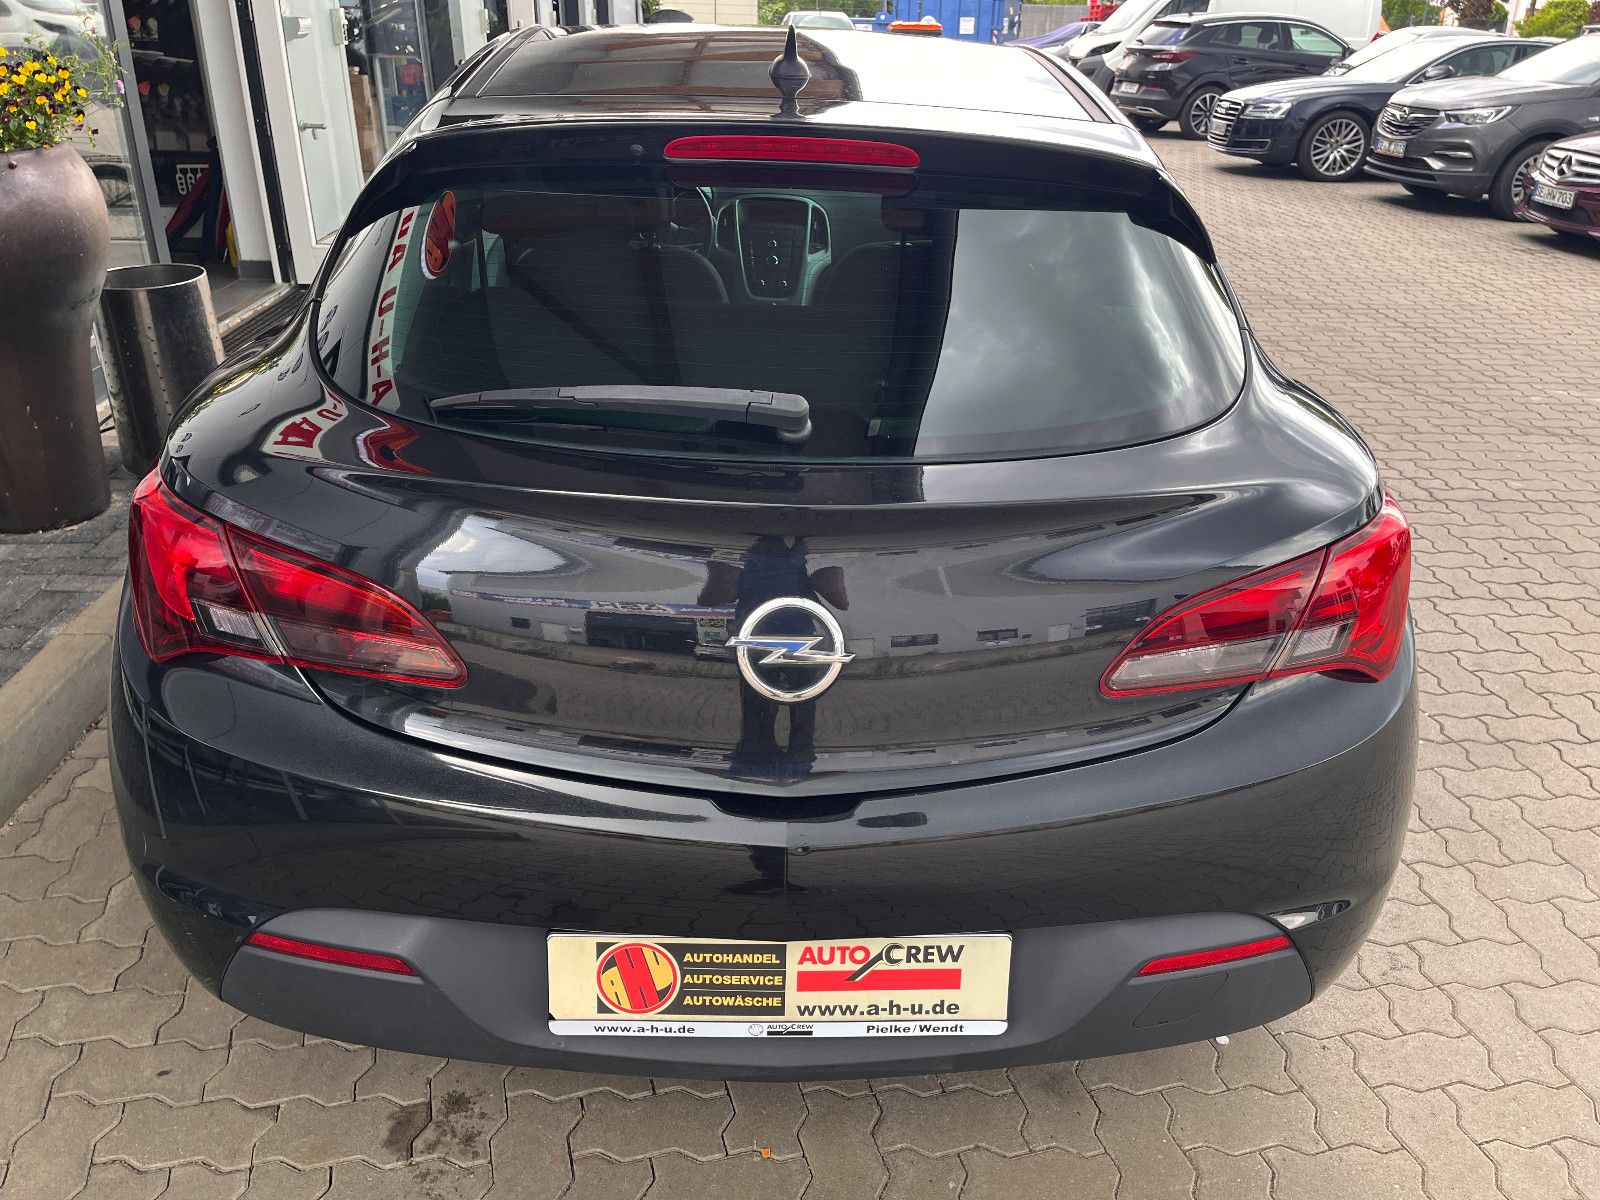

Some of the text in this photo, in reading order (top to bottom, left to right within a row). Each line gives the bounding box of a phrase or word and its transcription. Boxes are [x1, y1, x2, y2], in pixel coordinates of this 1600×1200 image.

[683, 952, 780, 964] AUTOHANDEL
[797, 943, 966, 966] AUTO CREW
[683, 974, 783, 985] AUTOSERVICE
[683, 994, 782, 1007] AUTOWÄSCHE
[796, 999, 960, 1017] www.a-h-u.de
[593, 1024, 696, 1035] www.a-h-u.de
[866, 1023, 965, 1034] Pielke/Wendt
